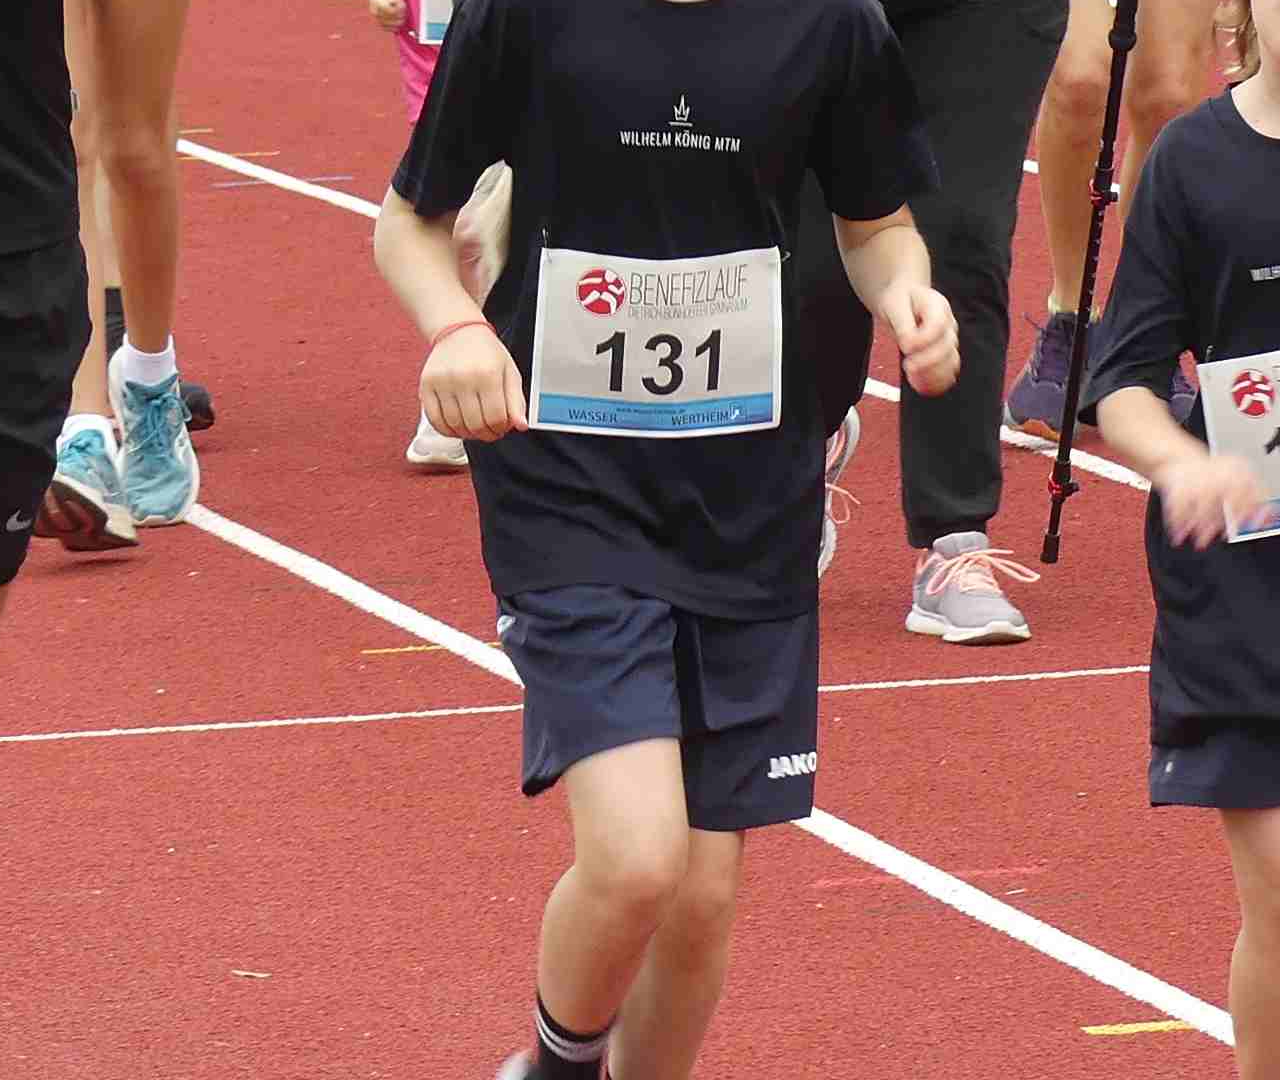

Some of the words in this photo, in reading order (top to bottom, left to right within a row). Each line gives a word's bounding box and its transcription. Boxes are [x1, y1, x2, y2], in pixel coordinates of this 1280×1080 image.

[620, 130, 672, 147] WILHELM
[674, 129, 711, 150] KÖNIG
[714, 136, 741, 152] MTM
[629, 264, 748, 306] BENEFIZLAUF
[595, 329, 721, 395] 131
[568, 408, 617, 423] WASSER
[671, 410, 730, 426] WERTHEIM
[767, 752, 817, 779] JAKO
